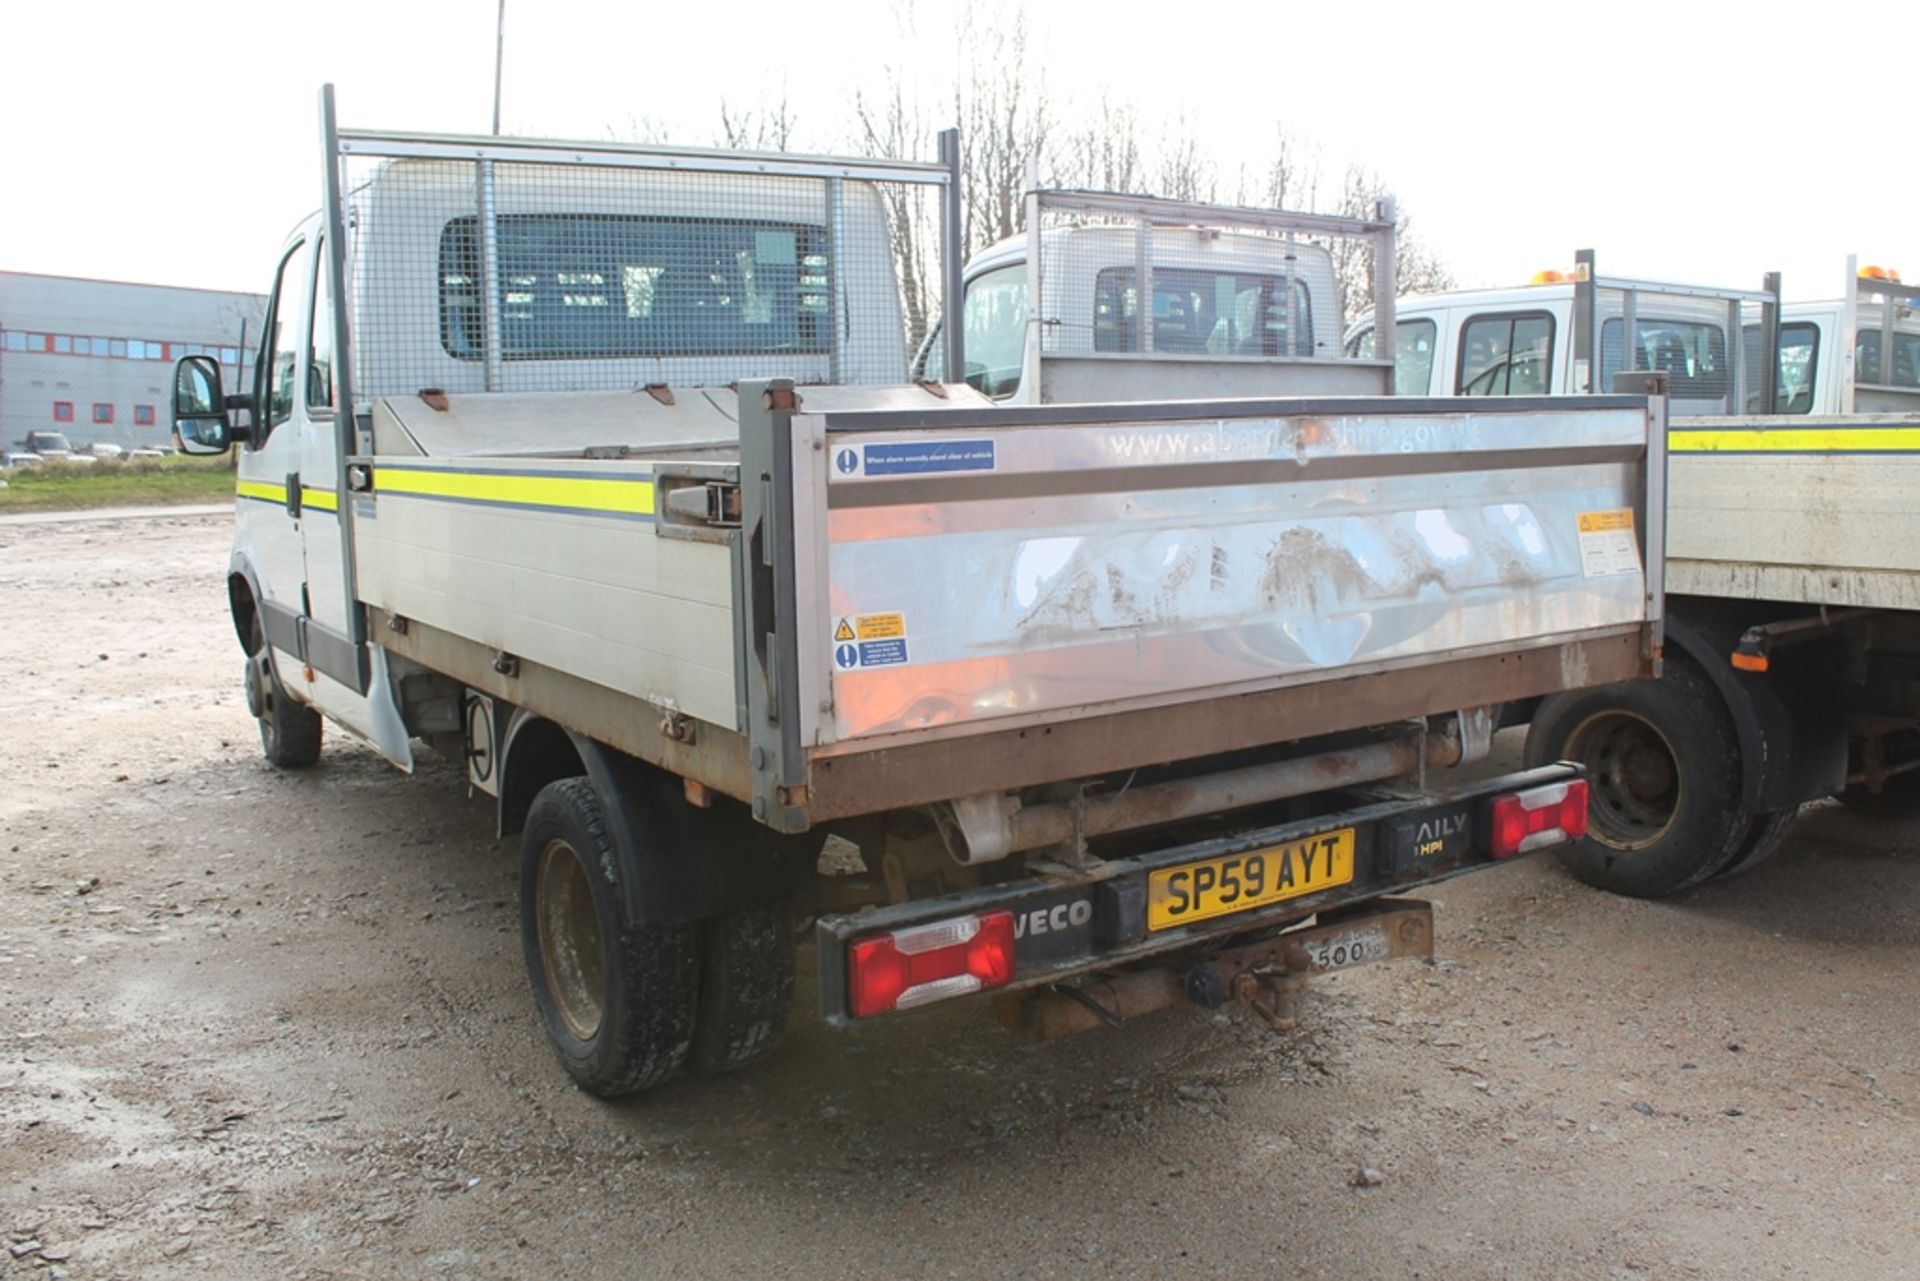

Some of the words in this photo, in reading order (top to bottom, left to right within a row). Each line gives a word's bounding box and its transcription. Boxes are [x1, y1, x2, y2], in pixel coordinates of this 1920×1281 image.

[1110, 414, 1480, 457] www.aberdeshire.govuk
[1416, 812, 1467, 842] AILY
[1420, 839, 1443, 856] HPI
[1167, 855, 1265, 915] SP59
[1276, 836, 1340, 891] AYT
[1013, 899, 1092, 940] VECO
